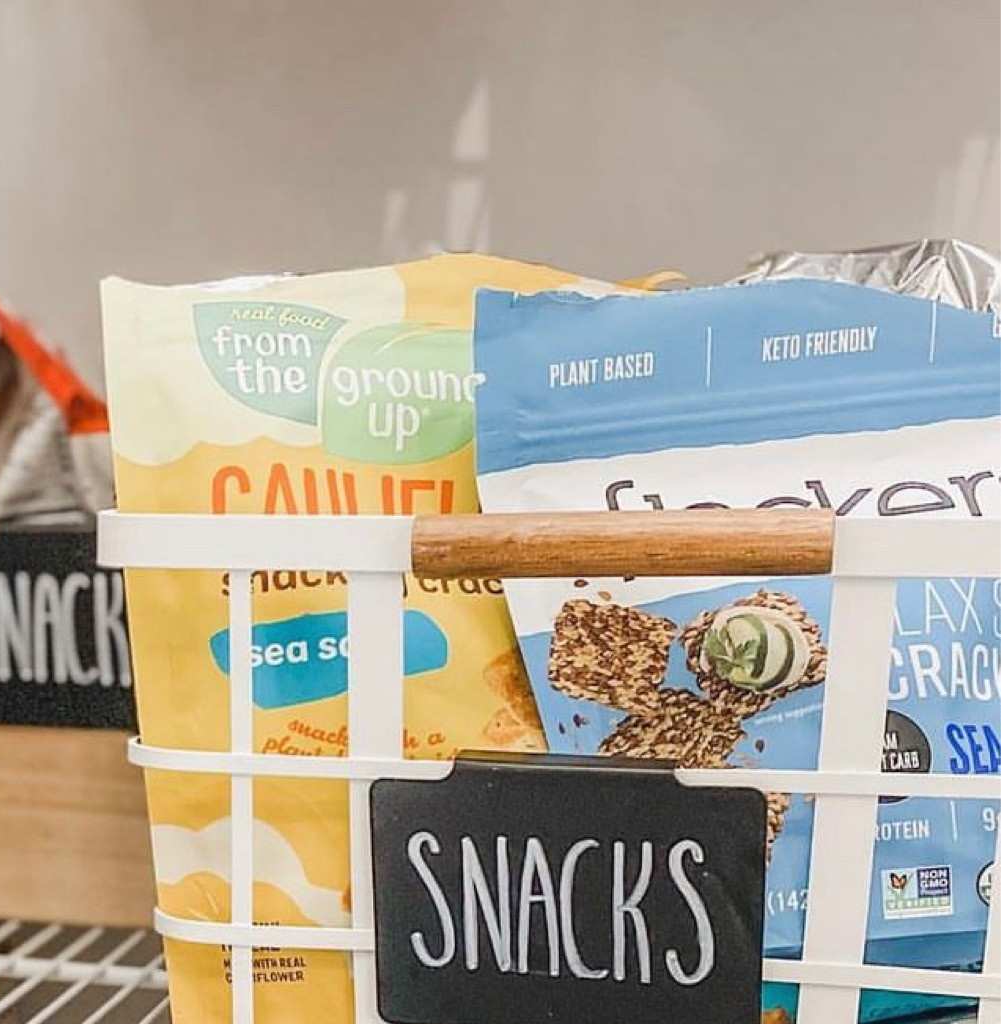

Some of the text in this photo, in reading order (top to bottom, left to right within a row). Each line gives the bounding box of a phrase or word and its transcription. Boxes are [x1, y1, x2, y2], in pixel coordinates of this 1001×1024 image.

[279, 310, 329, 330] food
[213, 325, 312, 357] from
[761, 326, 878, 362] KETO FRIENDLY
[228, 360, 309, 393] the
[549, 351, 654, 389] PLANT BASED
[368, 400, 421, 451] up
[893, 578, 983, 635] LAX
[250, 637, 309, 668] sea
[888, 642, 1001, 700] CRAC
[890, 750, 920, 770] CARB
[875, 819, 930, 842] ROTEIN
[920, 878, 948, 889] GMO
[407, 831, 717, 986] SNACKS
[279, 956, 306, 968] REAL
